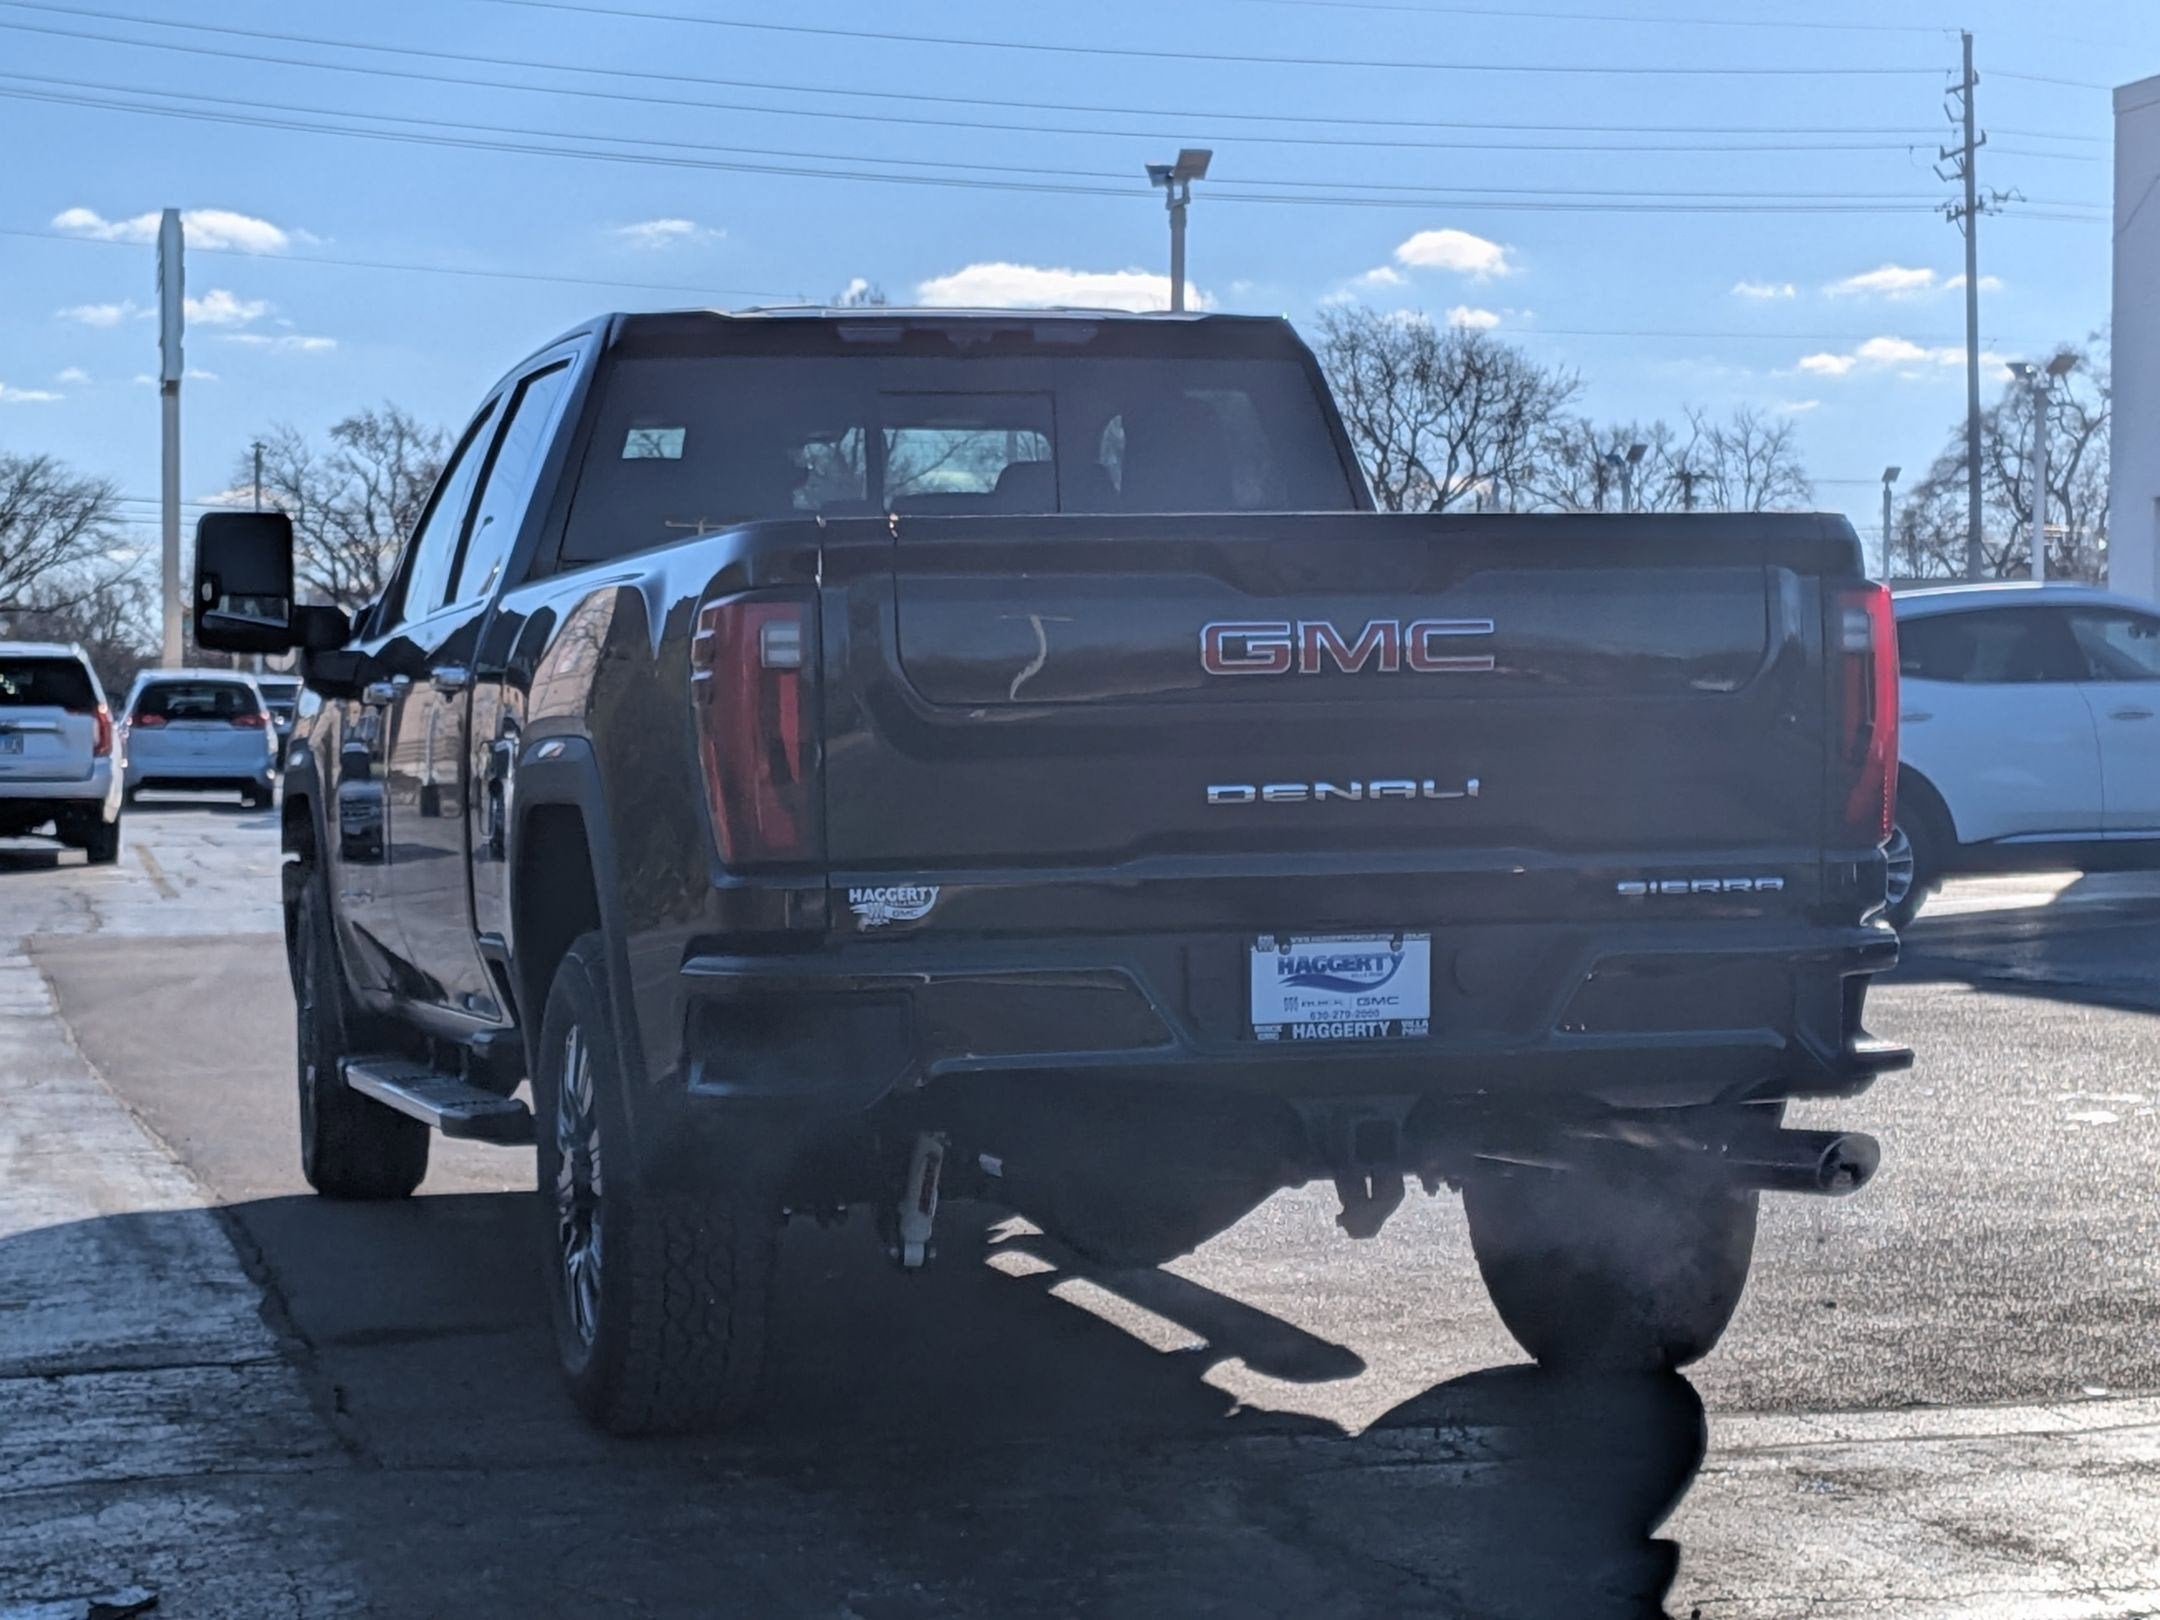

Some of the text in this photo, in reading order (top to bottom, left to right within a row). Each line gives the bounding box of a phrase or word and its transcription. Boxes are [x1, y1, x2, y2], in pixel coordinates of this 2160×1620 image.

[1200, 618, 1495, 675] GMC
[1206, 777, 1480, 805] DENALI
[848, 885, 940, 904] HAGGERTY
[1617, 876, 1784, 896] SIERRA
[1277, 951, 1406, 976] HAGGERTY
[1356, 995, 1400, 1007] GMC
[1292, 1021, 1391, 1040] HAGGERTY
